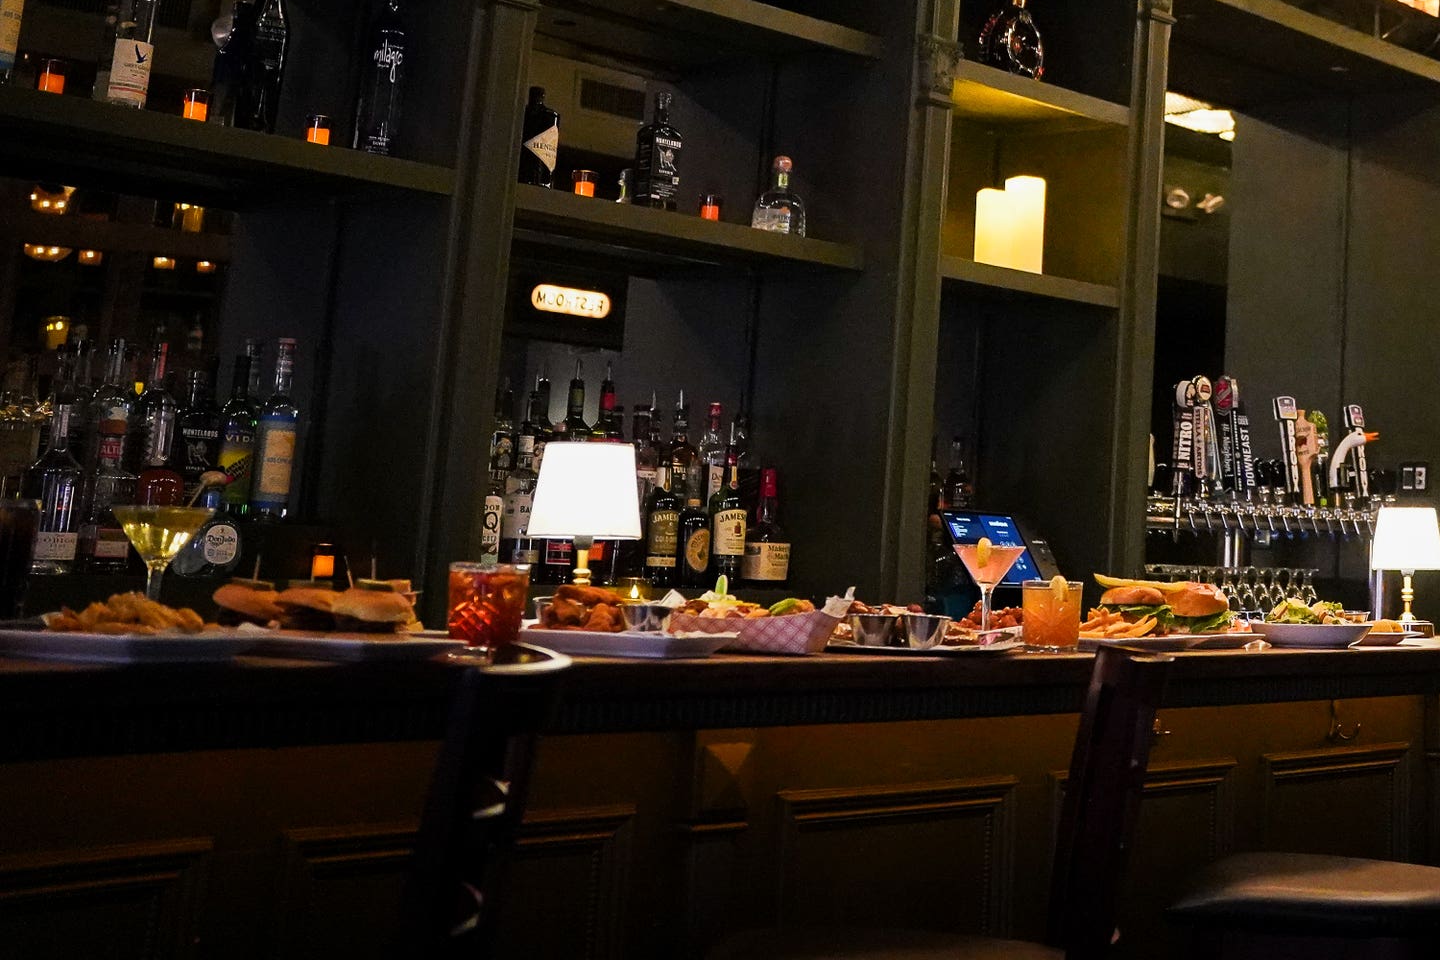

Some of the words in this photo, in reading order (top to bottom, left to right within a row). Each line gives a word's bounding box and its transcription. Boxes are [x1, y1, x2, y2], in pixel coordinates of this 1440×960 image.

[373, 38, 404, 83] milagro
[1177, 421, 1193, 461] NITRO
[1194, 408, 1202, 437] STELLA
[1240, 428, 1256, 487] DOWNEAST
[484, 511, 498, 533] Q
